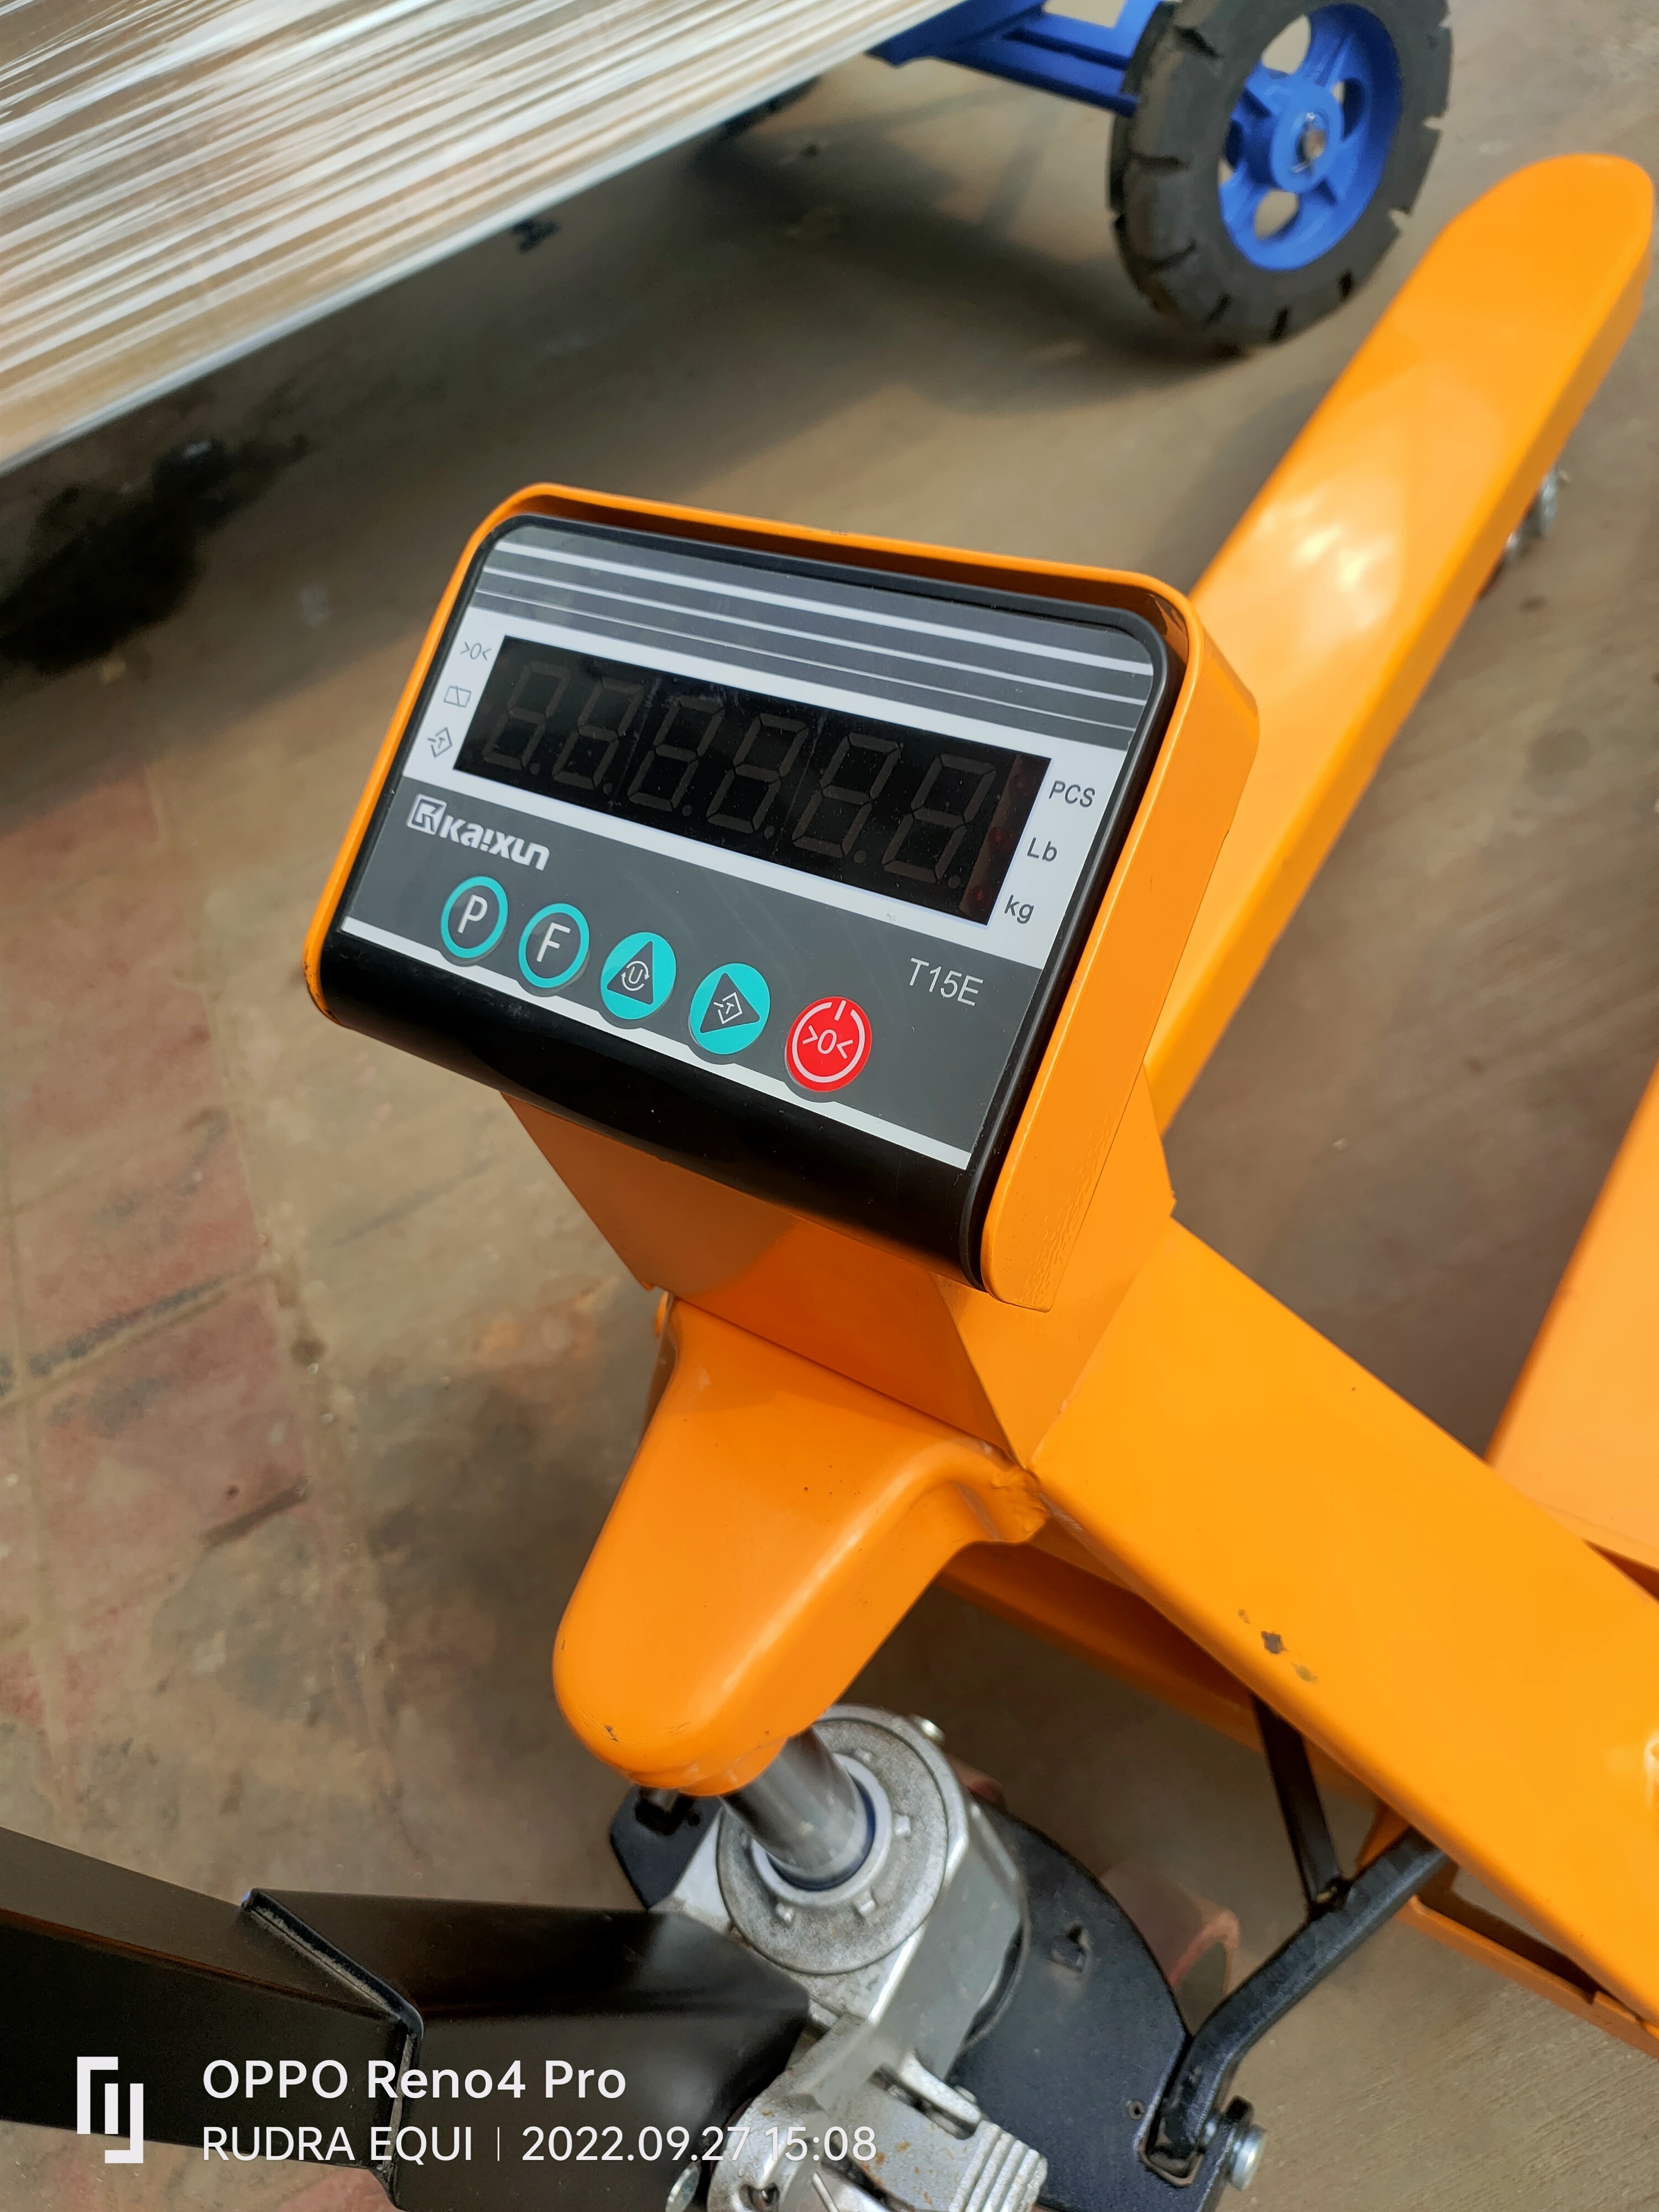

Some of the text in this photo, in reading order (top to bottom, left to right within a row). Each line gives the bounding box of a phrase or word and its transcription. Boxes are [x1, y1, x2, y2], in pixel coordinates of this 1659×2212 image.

[1047, 780, 1097, 809] PCS
[1026, 836, 1058, 863] Lb
[457, 894, 488, 934] P
[1004, 894, 1035, 925] kg
[536, 922, 571, 963] F
[907, 957, 985, 1006] T15E
